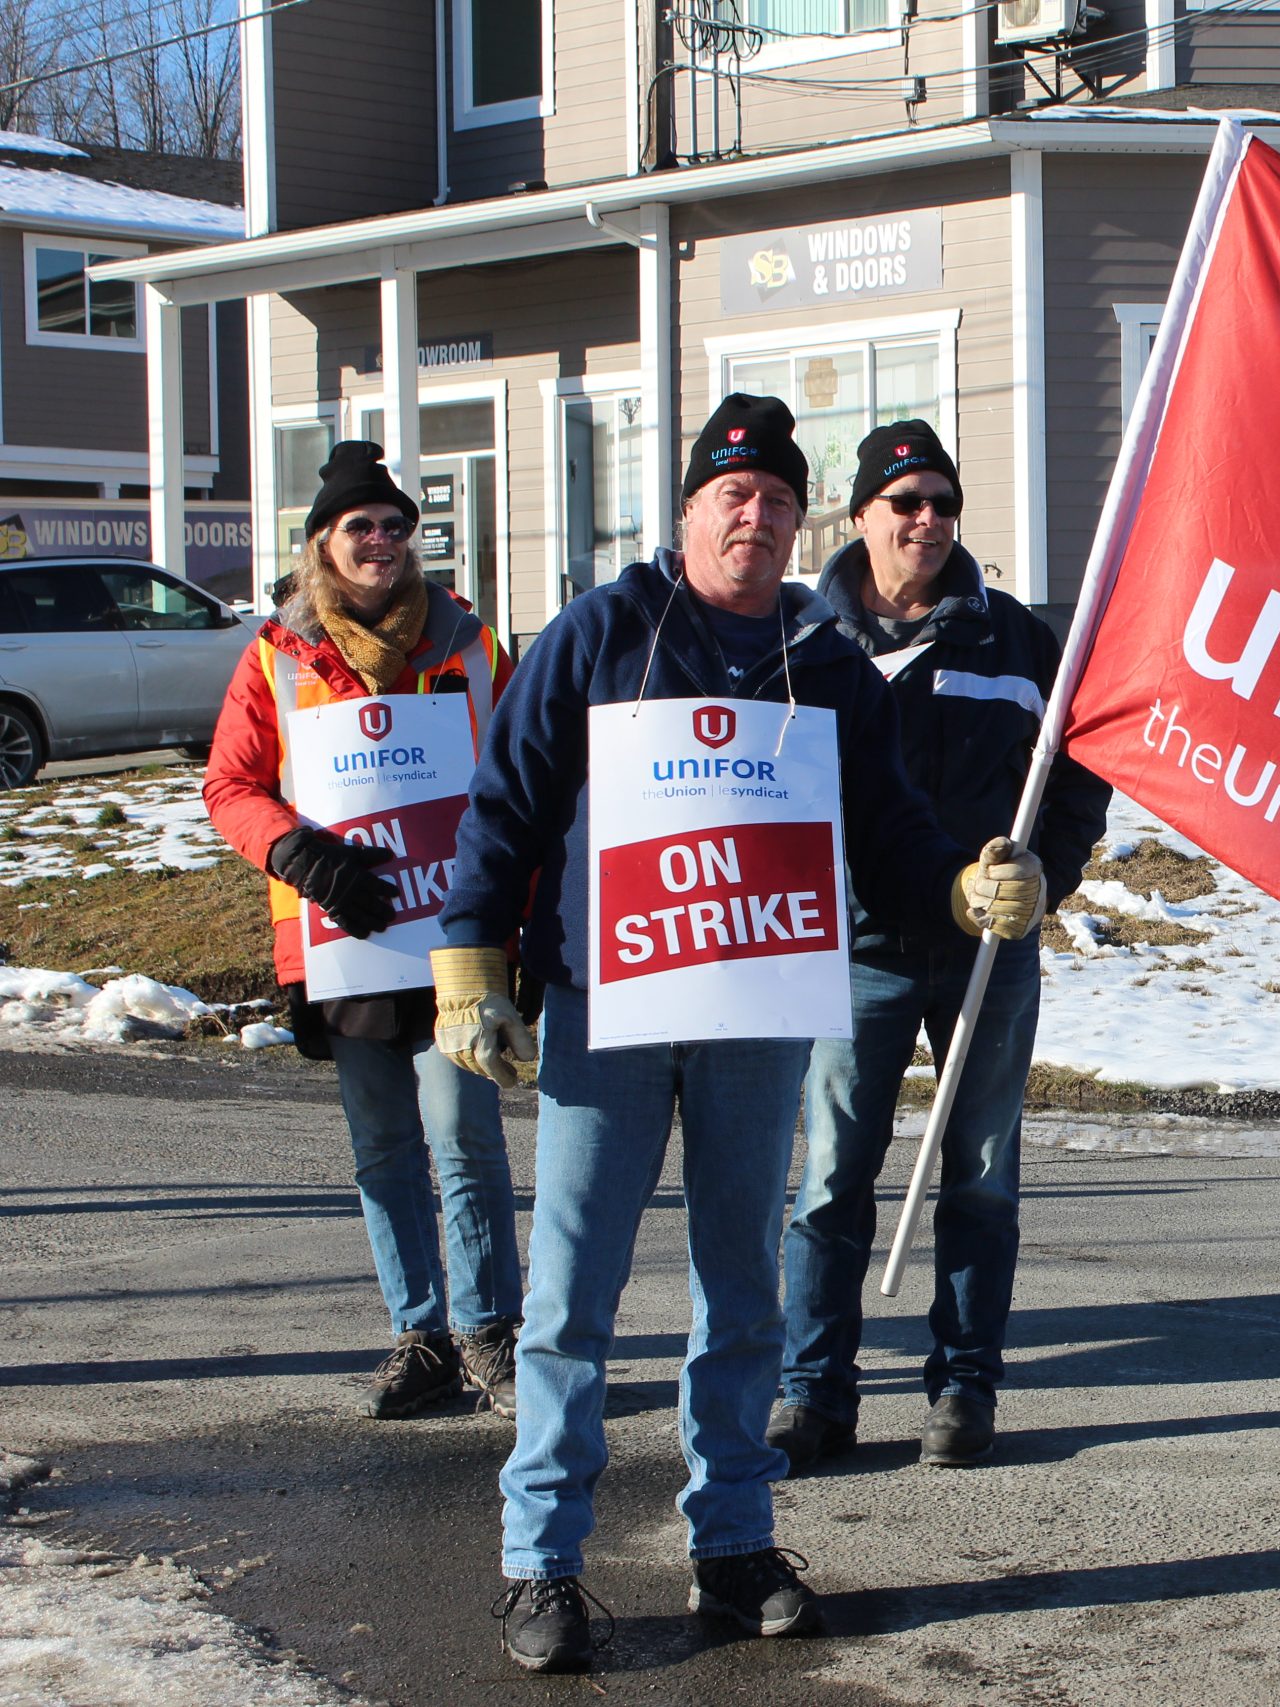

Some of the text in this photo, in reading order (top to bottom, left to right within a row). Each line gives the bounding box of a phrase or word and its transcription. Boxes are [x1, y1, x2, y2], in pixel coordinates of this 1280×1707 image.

[808, 220, 912, 262] WINDOWS
[813, 254, 907, 295] & DOORS
[417, 341, 481, 368] OWROOM
[34, 520, 147, 546] WINDOWS
[718, 786, 789, 800] lesyndicat
[659, 837, 742, 893] ON
[614, 891, 826, 965] STRIKE
